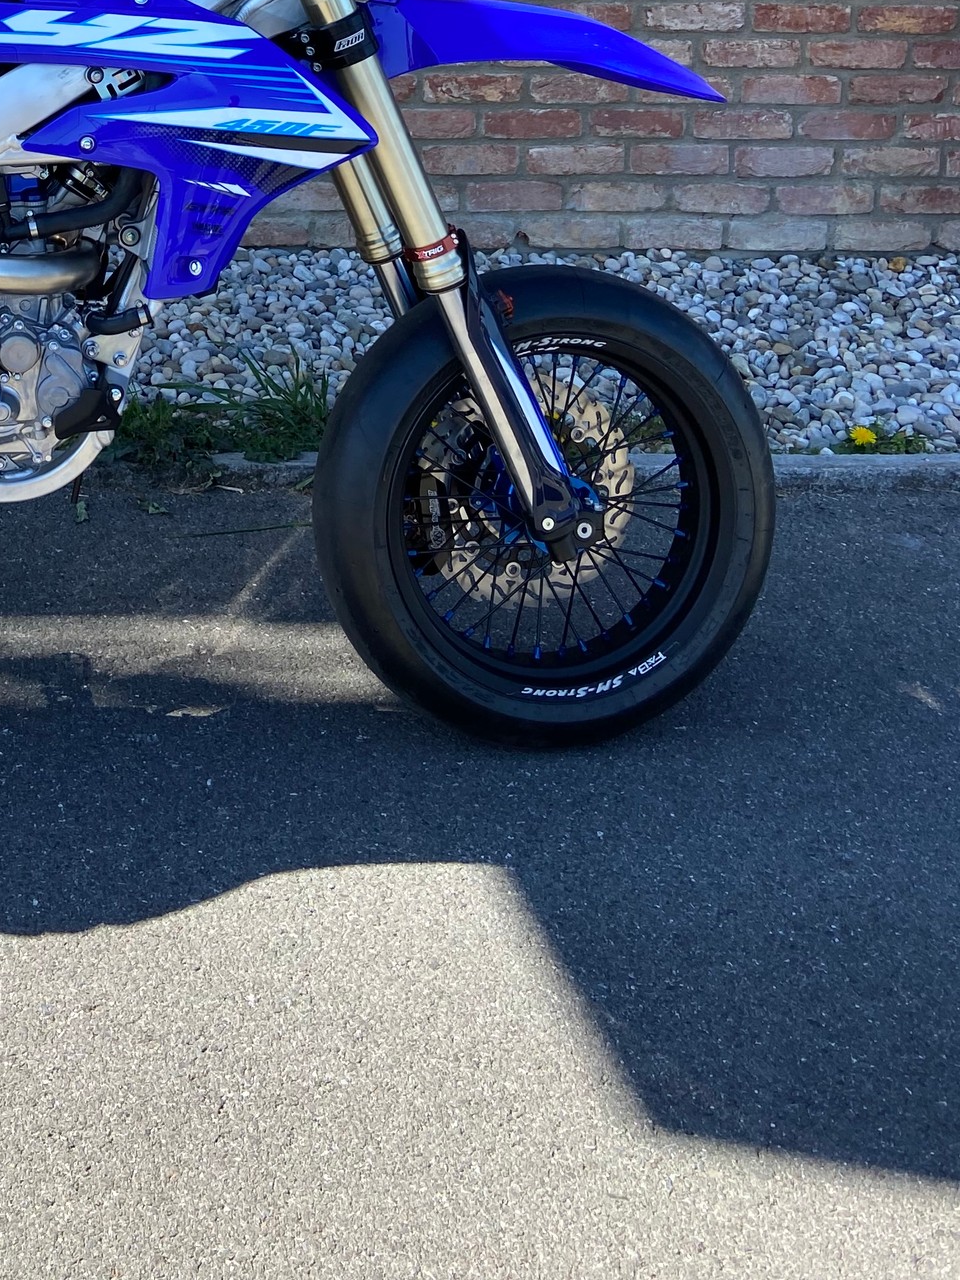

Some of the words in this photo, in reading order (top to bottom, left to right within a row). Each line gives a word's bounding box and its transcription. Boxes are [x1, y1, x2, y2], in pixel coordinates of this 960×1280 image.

[213, 118, 343, 136] 450F
[513, 336, 607, 352] M-STRONG
[521, 674, 624, 698] SM-STRONG
